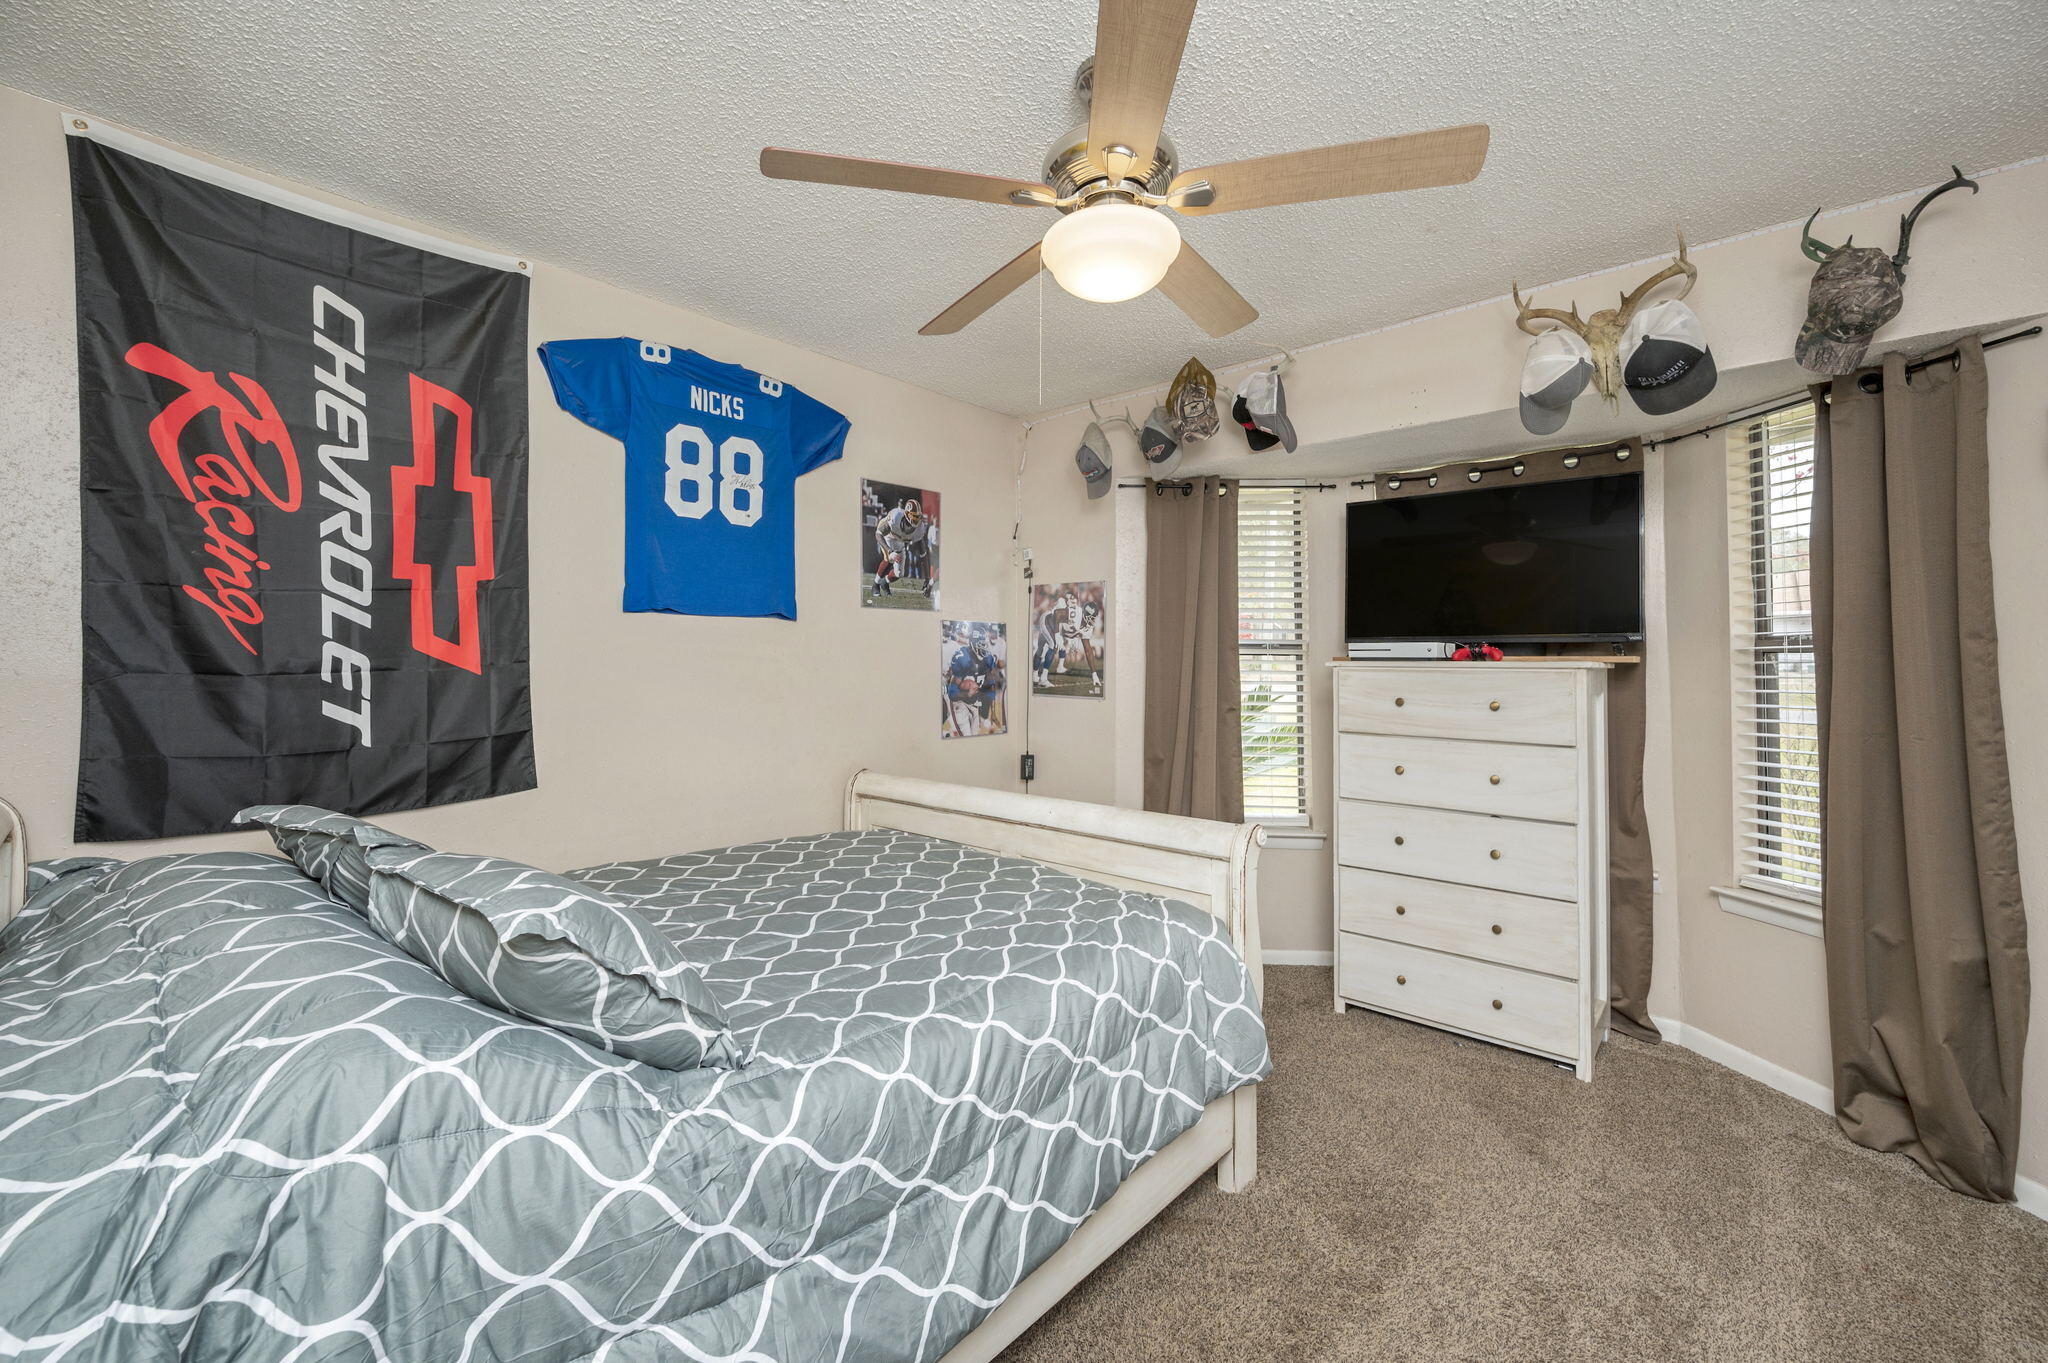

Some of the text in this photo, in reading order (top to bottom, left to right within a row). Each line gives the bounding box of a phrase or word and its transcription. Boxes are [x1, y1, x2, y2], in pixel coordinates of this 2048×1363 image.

[125, 343, 303, 655] Racing
[664, 423, 764, 527] 88
[690, 385, 744, 421] NICKS
[313, 285, 372, 748] CHEVROLET
